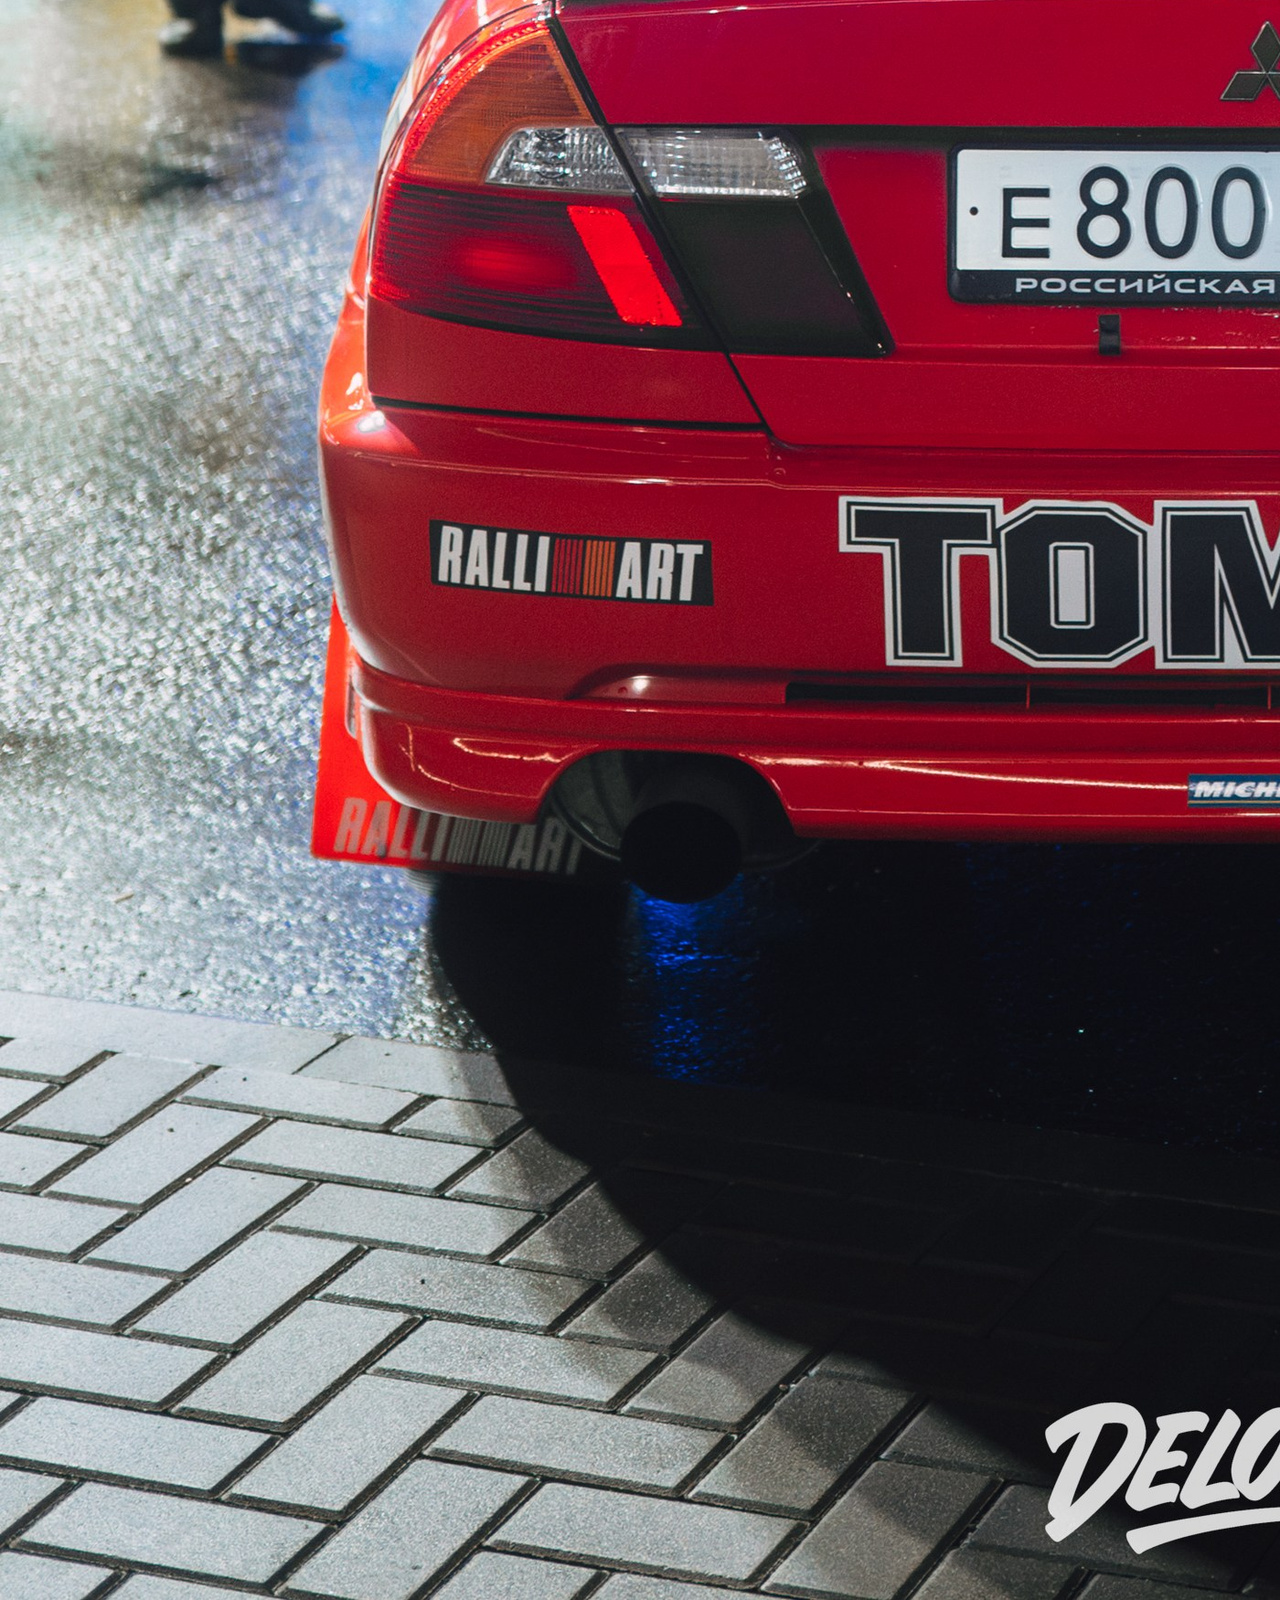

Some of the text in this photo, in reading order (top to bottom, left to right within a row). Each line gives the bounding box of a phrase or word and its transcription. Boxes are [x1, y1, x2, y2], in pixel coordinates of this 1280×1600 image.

[1014, 273, 1276, 296] РОССИЙСКАЯ
[437, 525, 704, 602] RALLI ART
[332, 796, 452, 862] RALLI
